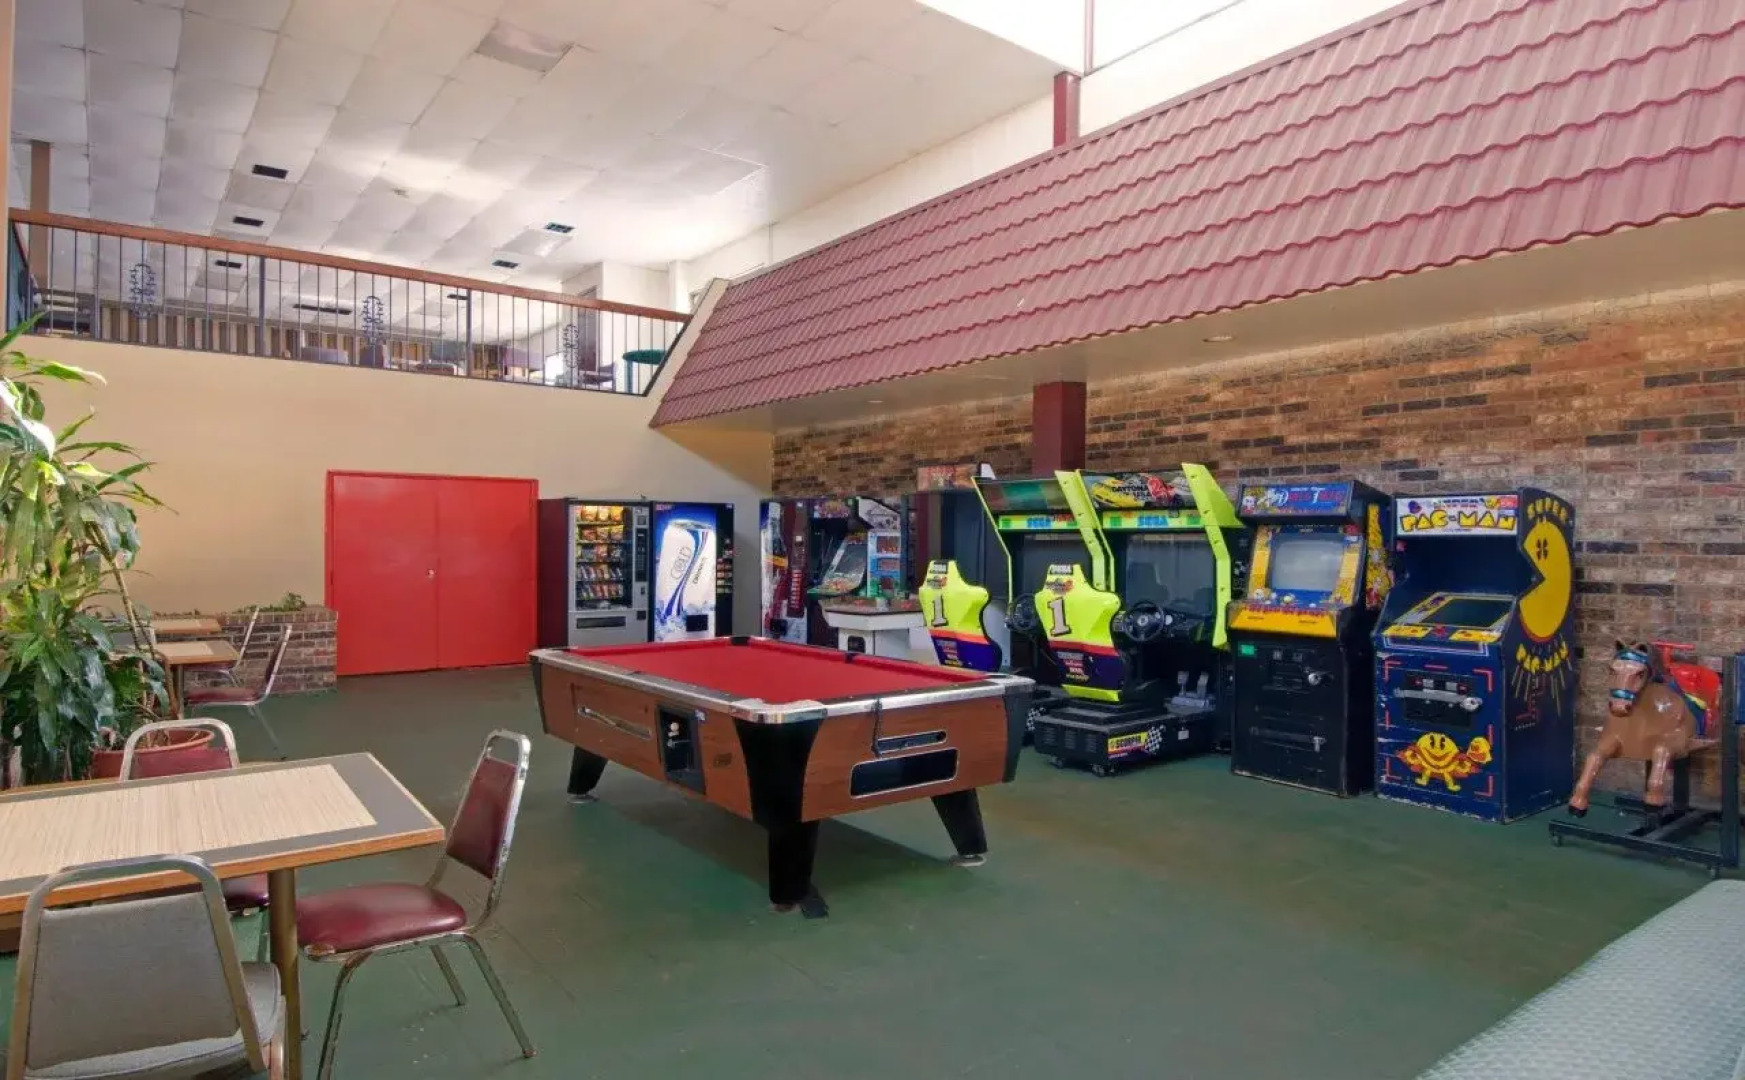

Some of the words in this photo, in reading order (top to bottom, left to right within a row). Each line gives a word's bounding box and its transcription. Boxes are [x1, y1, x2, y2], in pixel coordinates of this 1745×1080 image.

[1111, 485, 1149, 494] DAYTONA
[1026, 516, 1053, 528] SEGA
[1137, 515, 1168, 526] SEGA
[1400, 509, 1516, 532] PAC-MAN
[1527, 497, 1568, 523] SUPER
[930, 593, 949, 627] 1
[1047, 596, 1072, 637] 1
[1516, 641, 1569, 675] PAC-MAN
